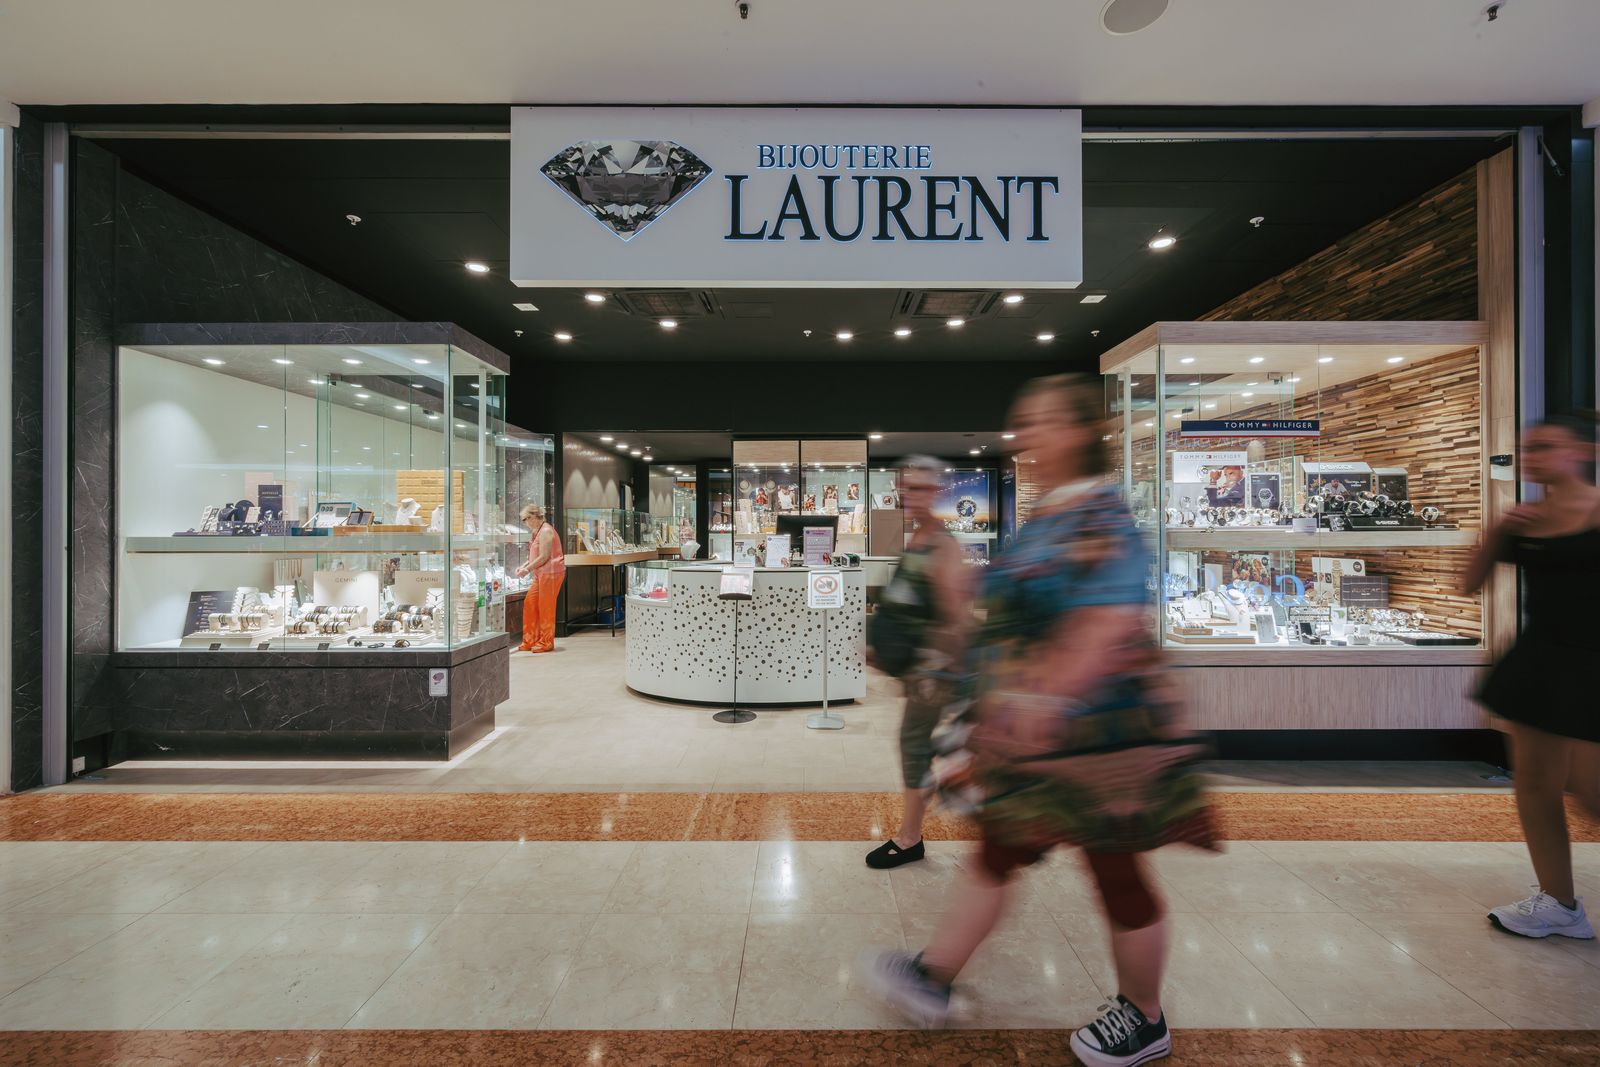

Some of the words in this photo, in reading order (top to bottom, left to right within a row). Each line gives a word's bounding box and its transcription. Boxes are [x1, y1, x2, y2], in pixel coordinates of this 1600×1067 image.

[756, 144, 933, 170] BIJOUTERIE
[724, 174, 1059, 242] LAURENT
[1224, 421, 1260, 429] TOMMY
[1272, 421, 1313, 429] HILFIGER
